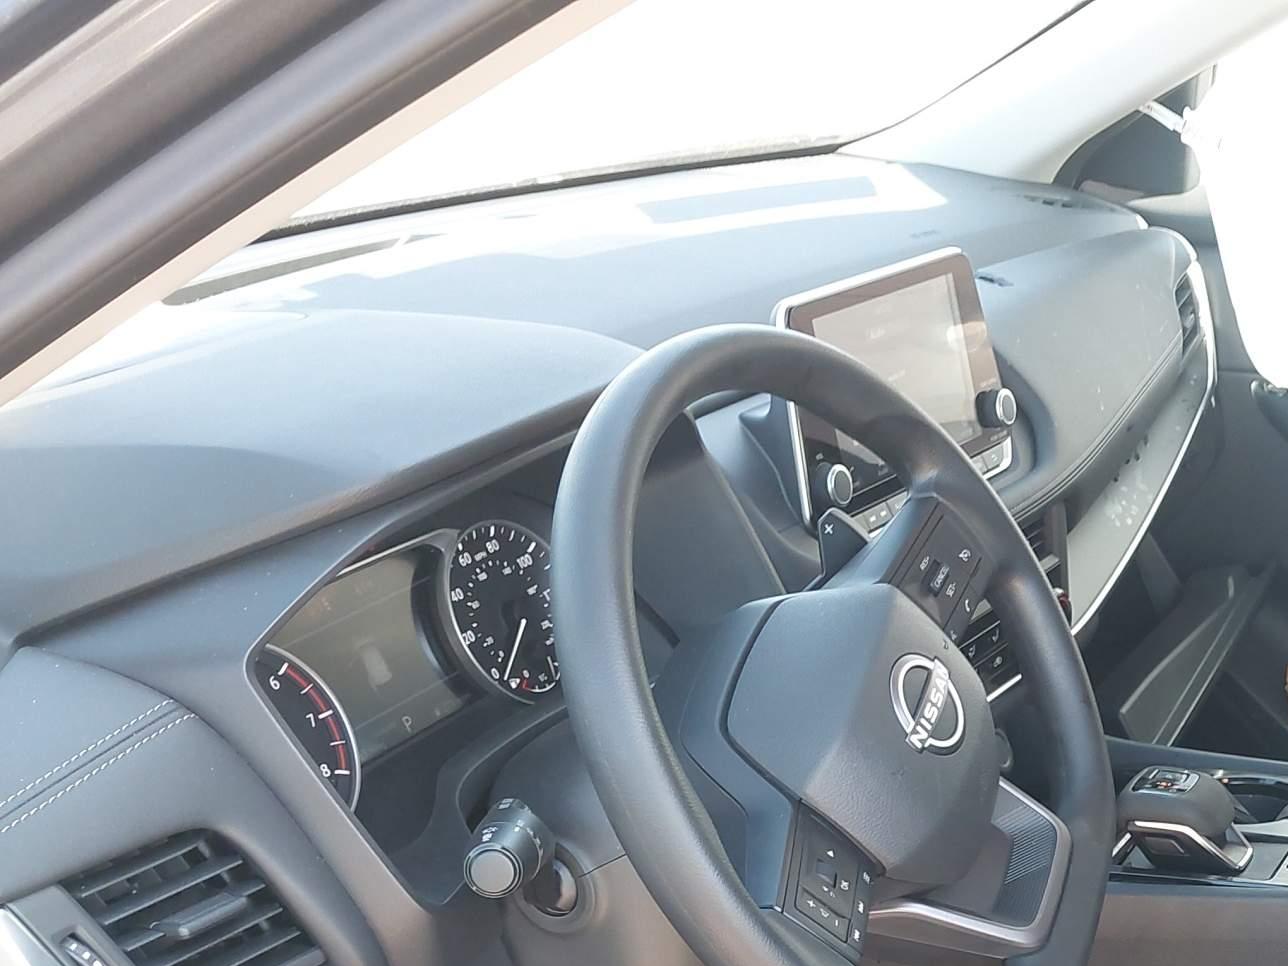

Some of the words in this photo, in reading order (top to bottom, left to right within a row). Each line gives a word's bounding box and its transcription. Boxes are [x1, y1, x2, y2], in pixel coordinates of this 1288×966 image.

[486, 539, 500, 554] 80
[459, 552, 472, 567] 60
[516, 553, 533, 568] 100
[451, 588, 464, 602] 40
[462, 630, 475, 646] 20
[491, 667, 500, 680] 0
[269, 675, 281, 691] 6
[908, 658, 950, 750] NISSAN
[305, 712, 316, 728] 7
[401, 715, 412, 734] P
[319, 763, 331, 778] 8
